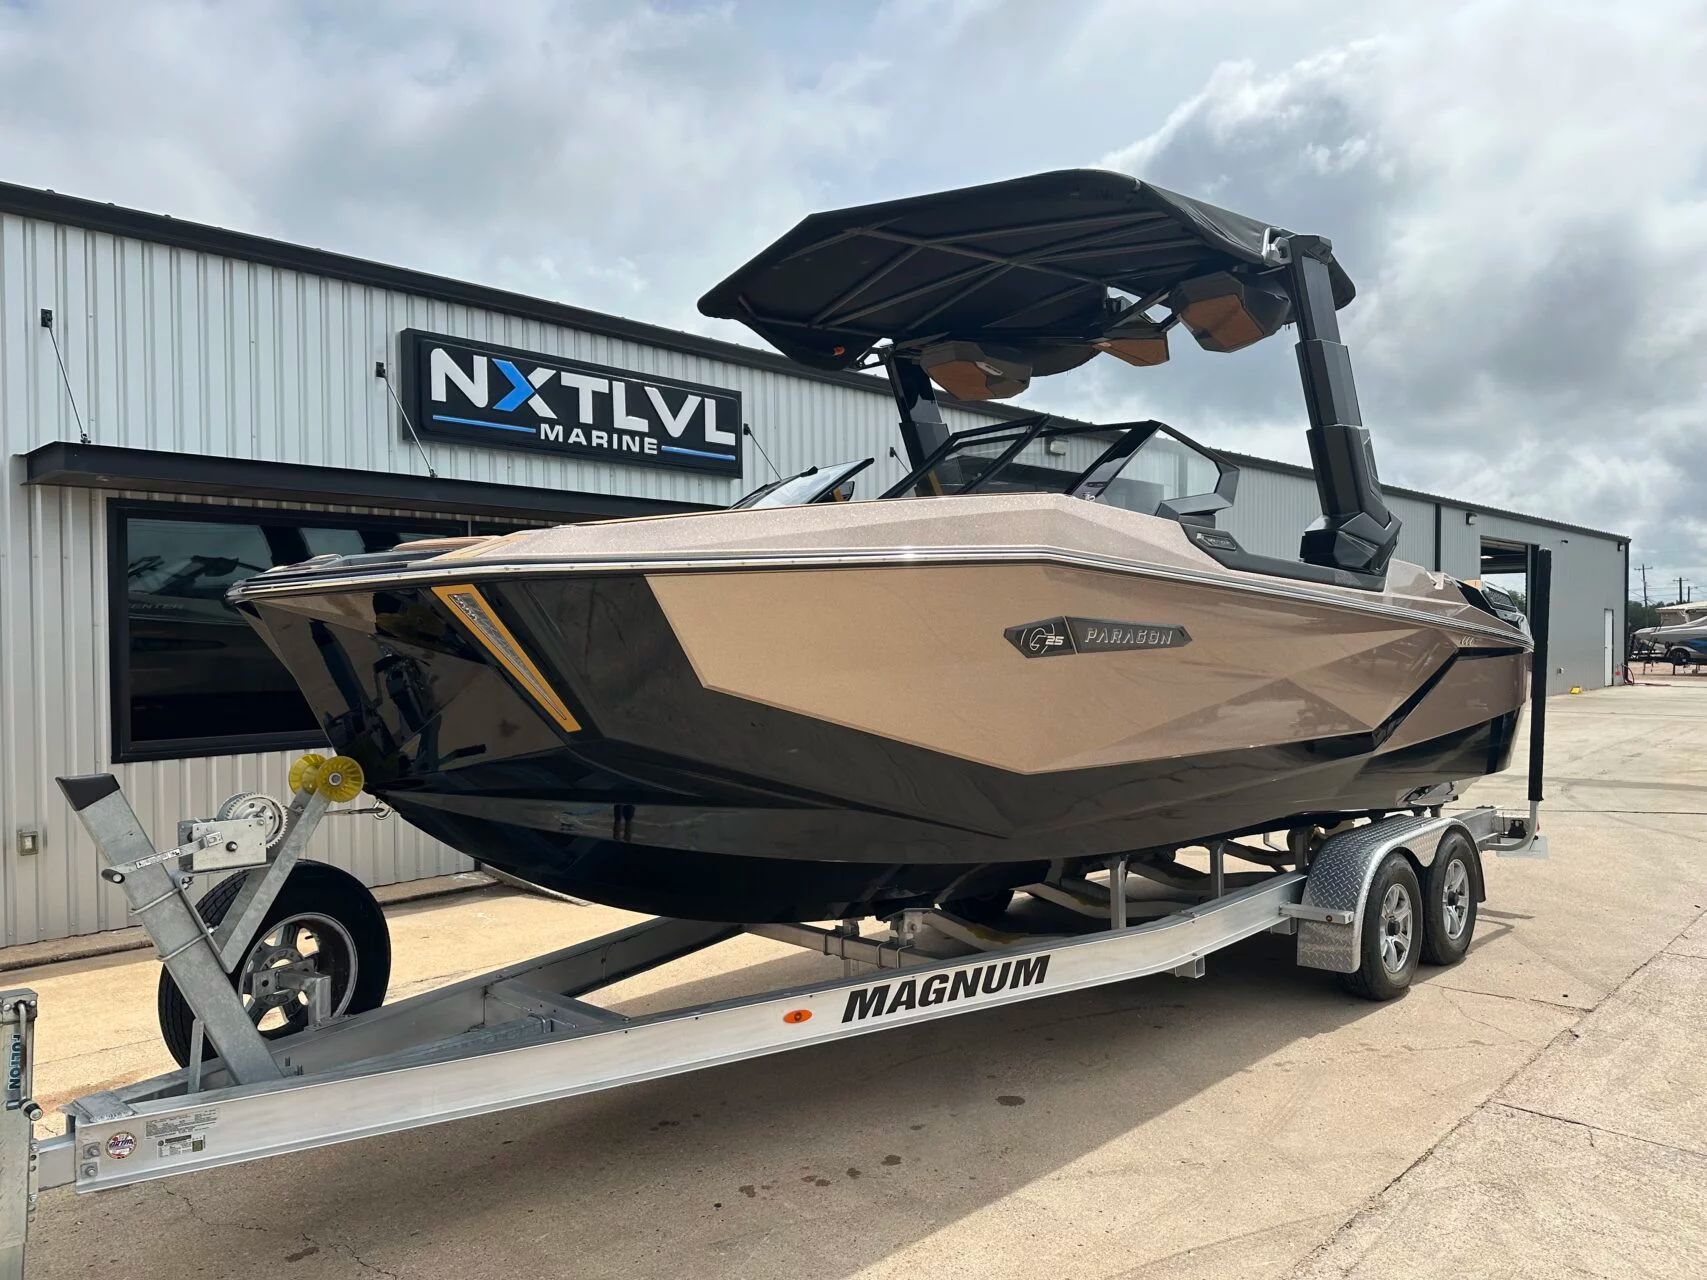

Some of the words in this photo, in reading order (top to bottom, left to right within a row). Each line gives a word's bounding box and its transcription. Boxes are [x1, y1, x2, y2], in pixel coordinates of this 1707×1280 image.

[430, 347, 736, 446] NXTLVL
[540, 423, 658, 455] MARINE
[1084, 627, 1174, 645] PARAGON
[841, 954, 1051, 1023] MAGNUM
[8, 1034, 21, 1090] FULTON
